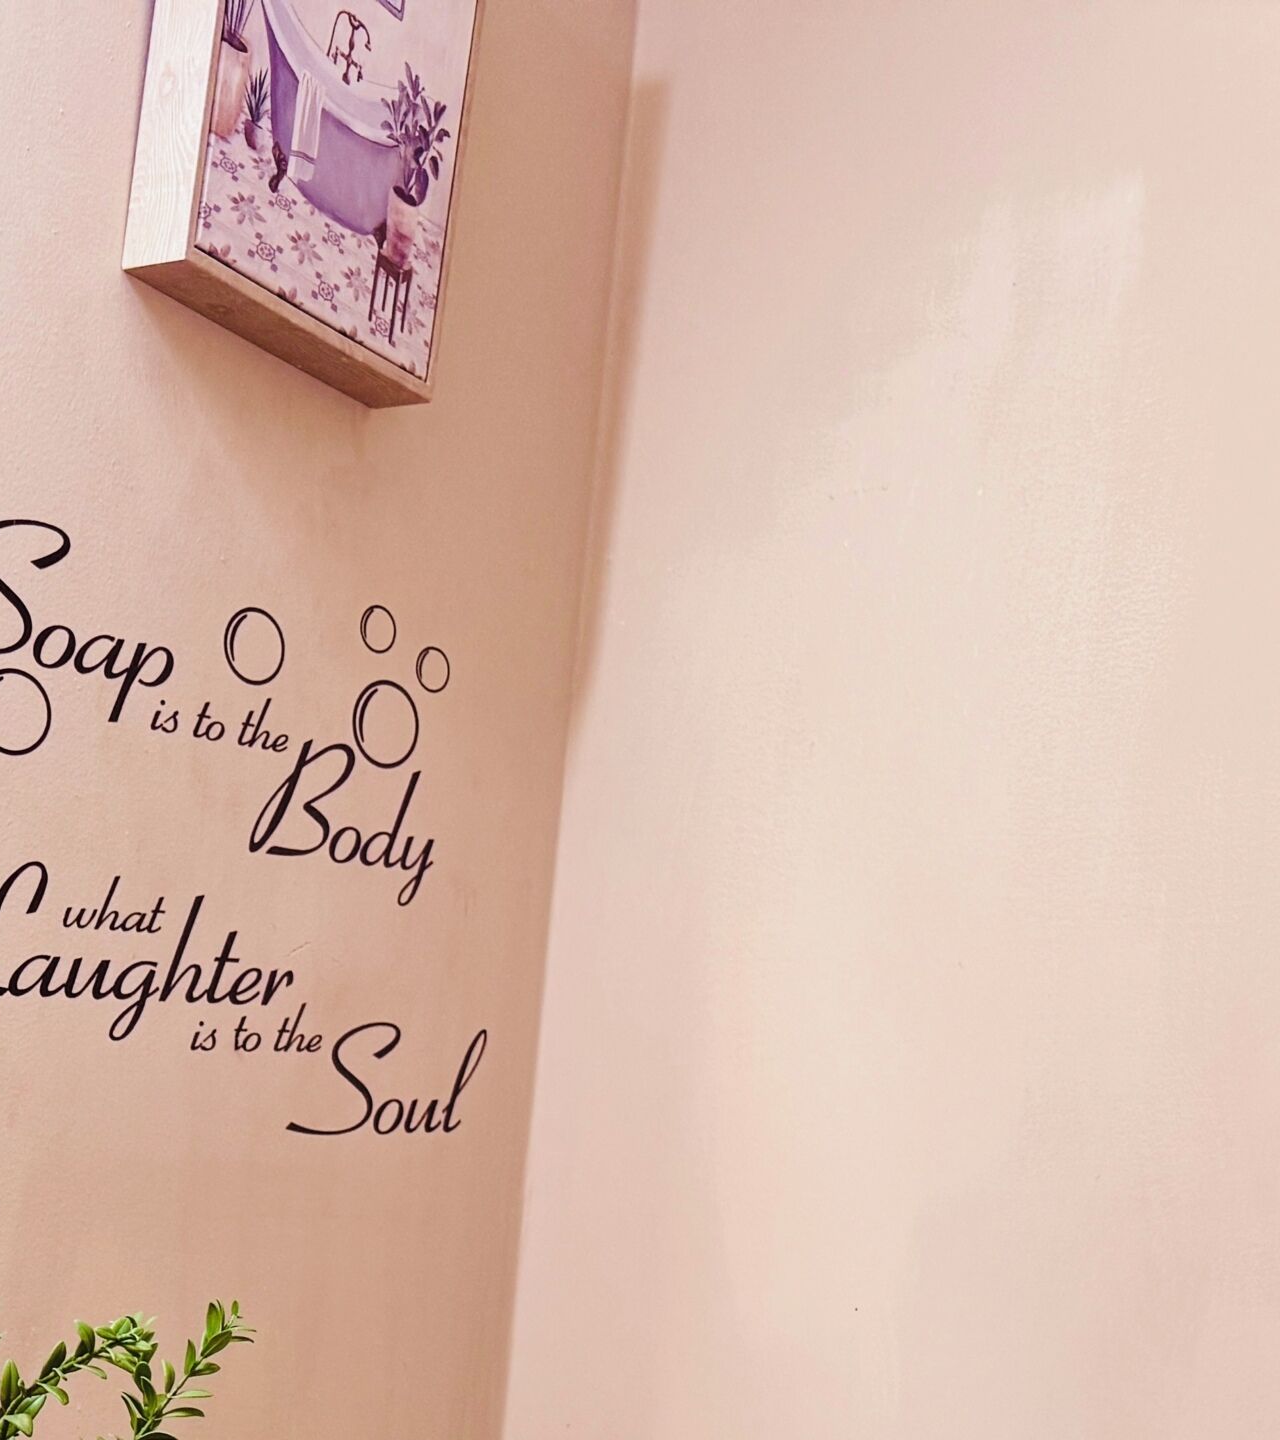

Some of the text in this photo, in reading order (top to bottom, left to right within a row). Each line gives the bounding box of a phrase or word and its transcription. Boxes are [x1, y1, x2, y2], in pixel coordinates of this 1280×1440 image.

[150, 697, 179, 733] is
[194, 700, 225, 742] to
[238, 698, 289, 754] the
[249, 739, 434, 906] Body
[63, 875, 166, 934] what
[190, 1003, 323, 1054] is to the
[285, 1021, 488, 1135] Soul
